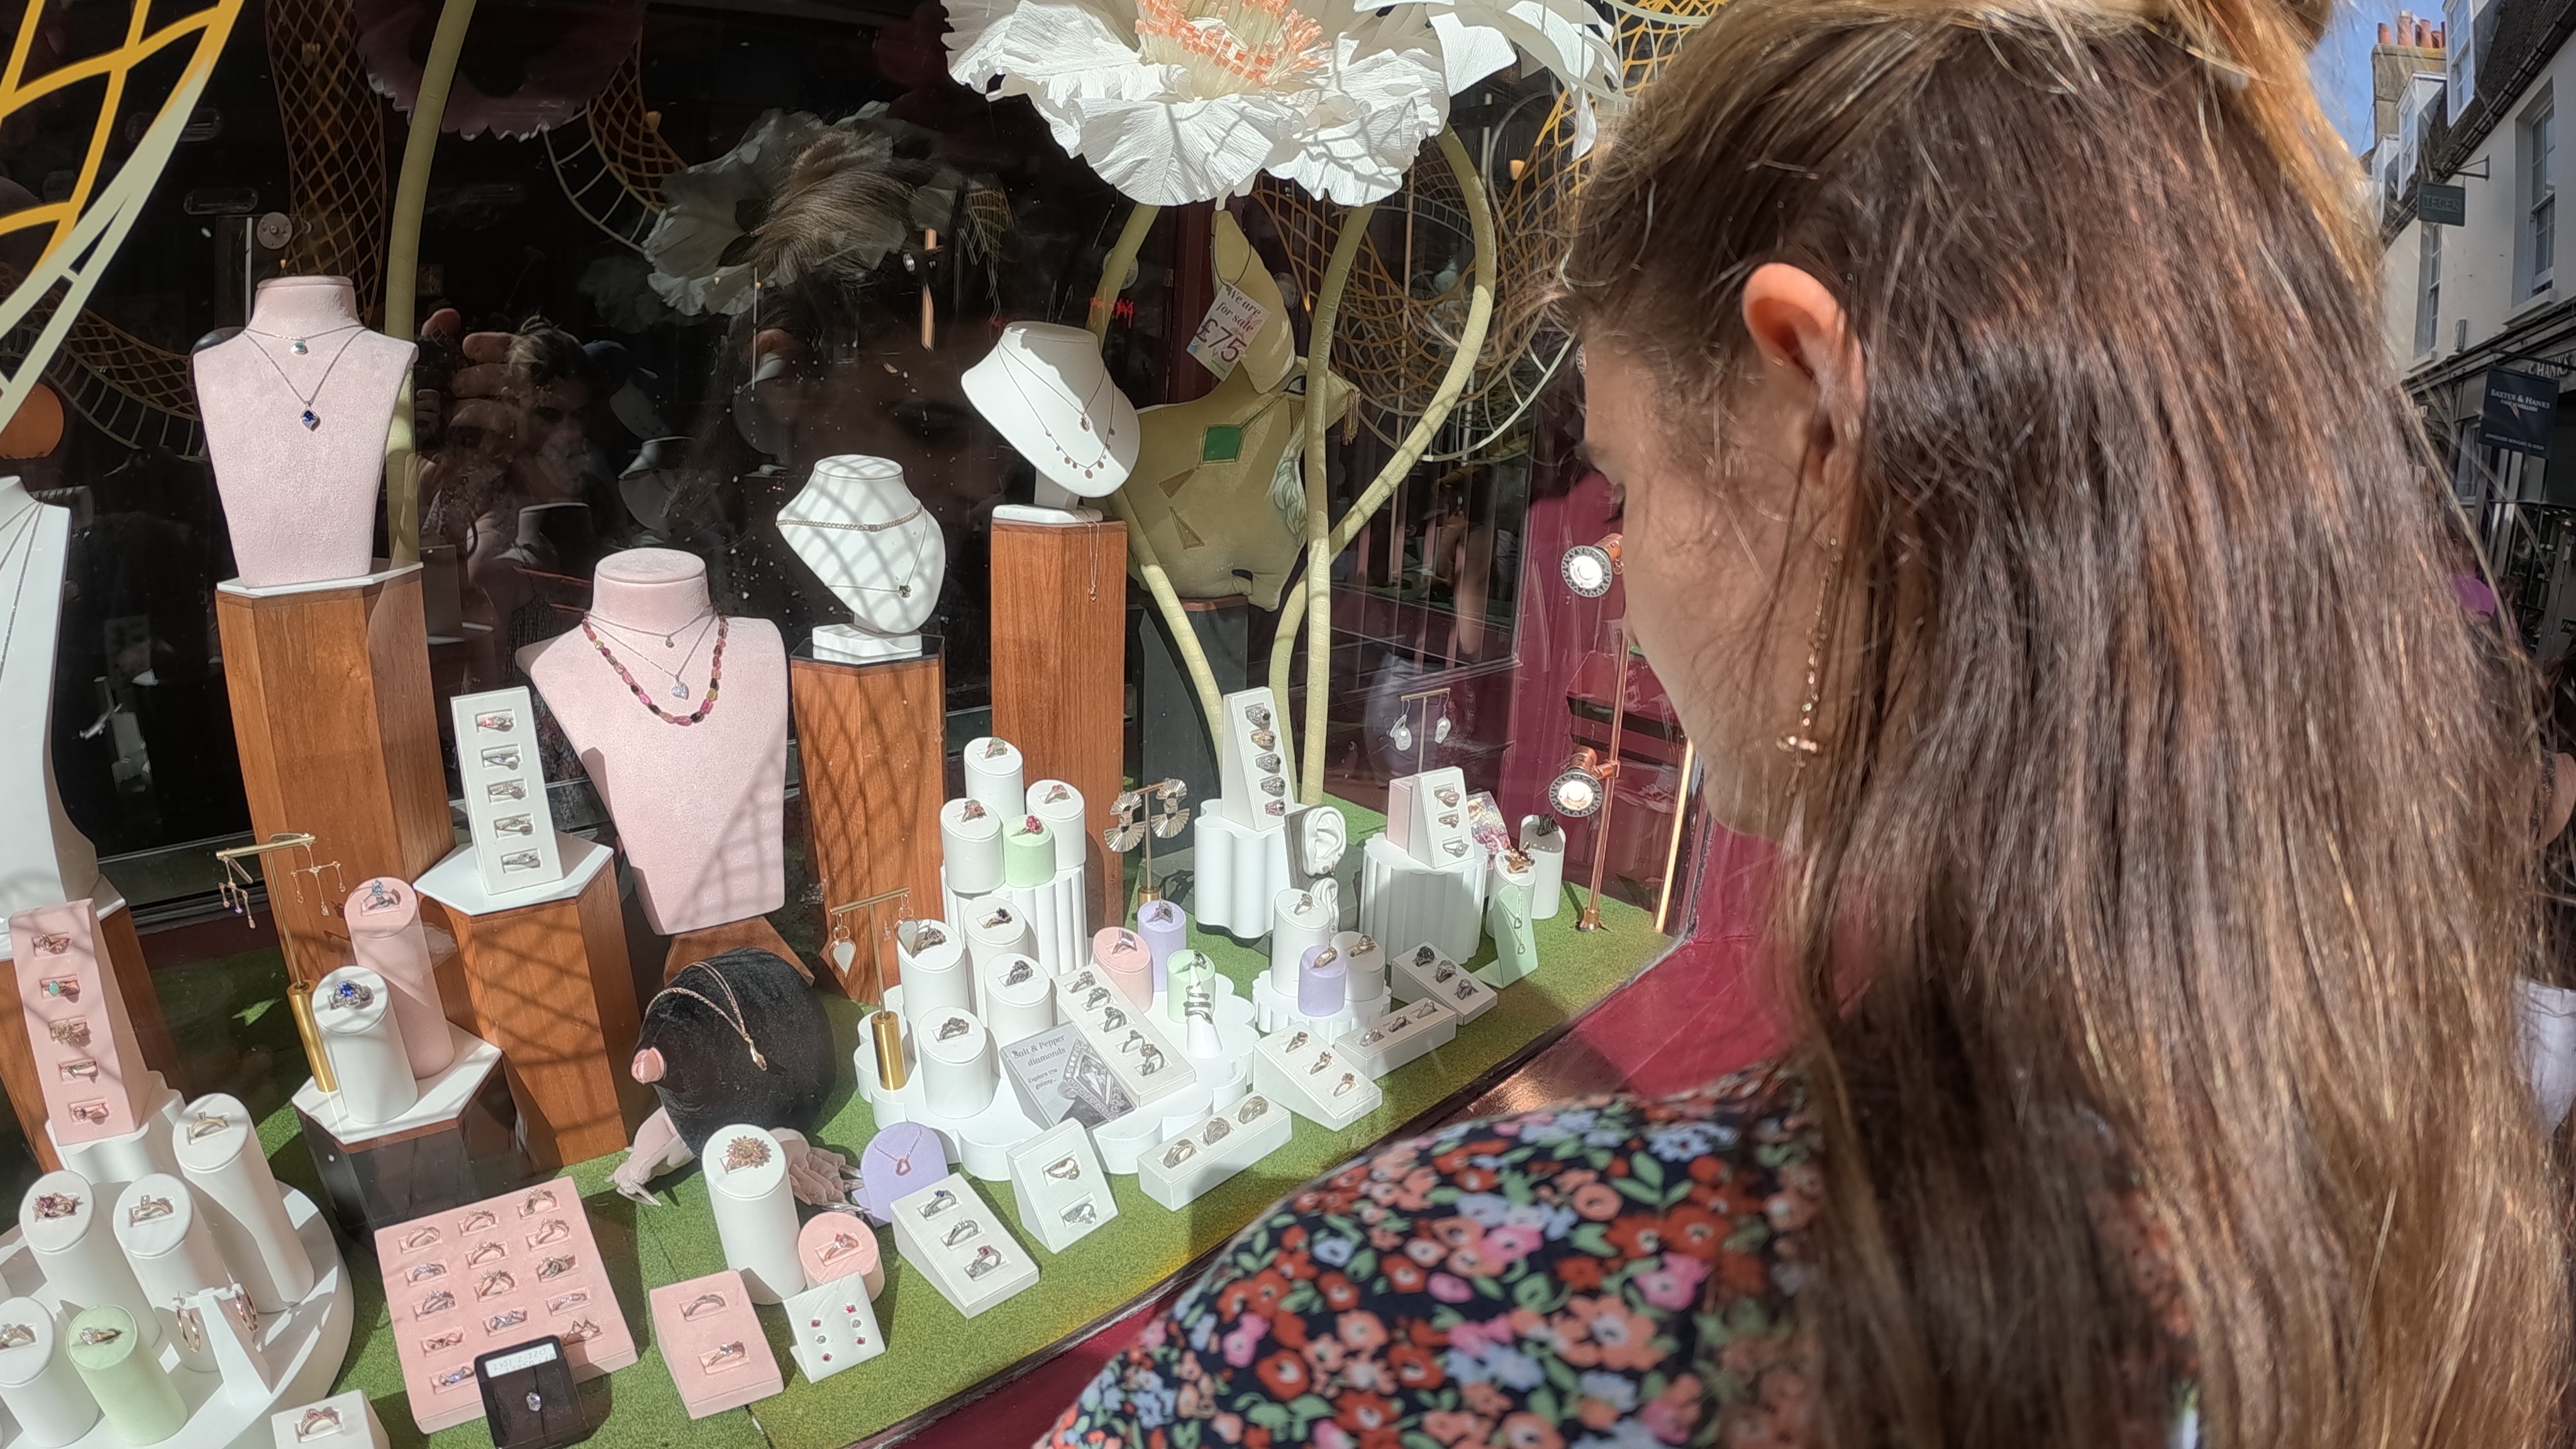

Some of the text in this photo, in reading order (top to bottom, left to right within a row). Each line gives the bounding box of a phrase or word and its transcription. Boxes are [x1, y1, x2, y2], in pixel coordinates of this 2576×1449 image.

[1226, 285, 1262, 318] We are
[1215, 301, 1254, 332] for sale
[1196, 318, 1248, 363] £75
[2490, 389, 2551, 409] BAXTER & HANKS
[1012, 1035, 1065, 1059] Salt & Pepper
[1028, 1046, 1067, 1067] diamonds
[1028, 1071, 1048, 1083] Explore
